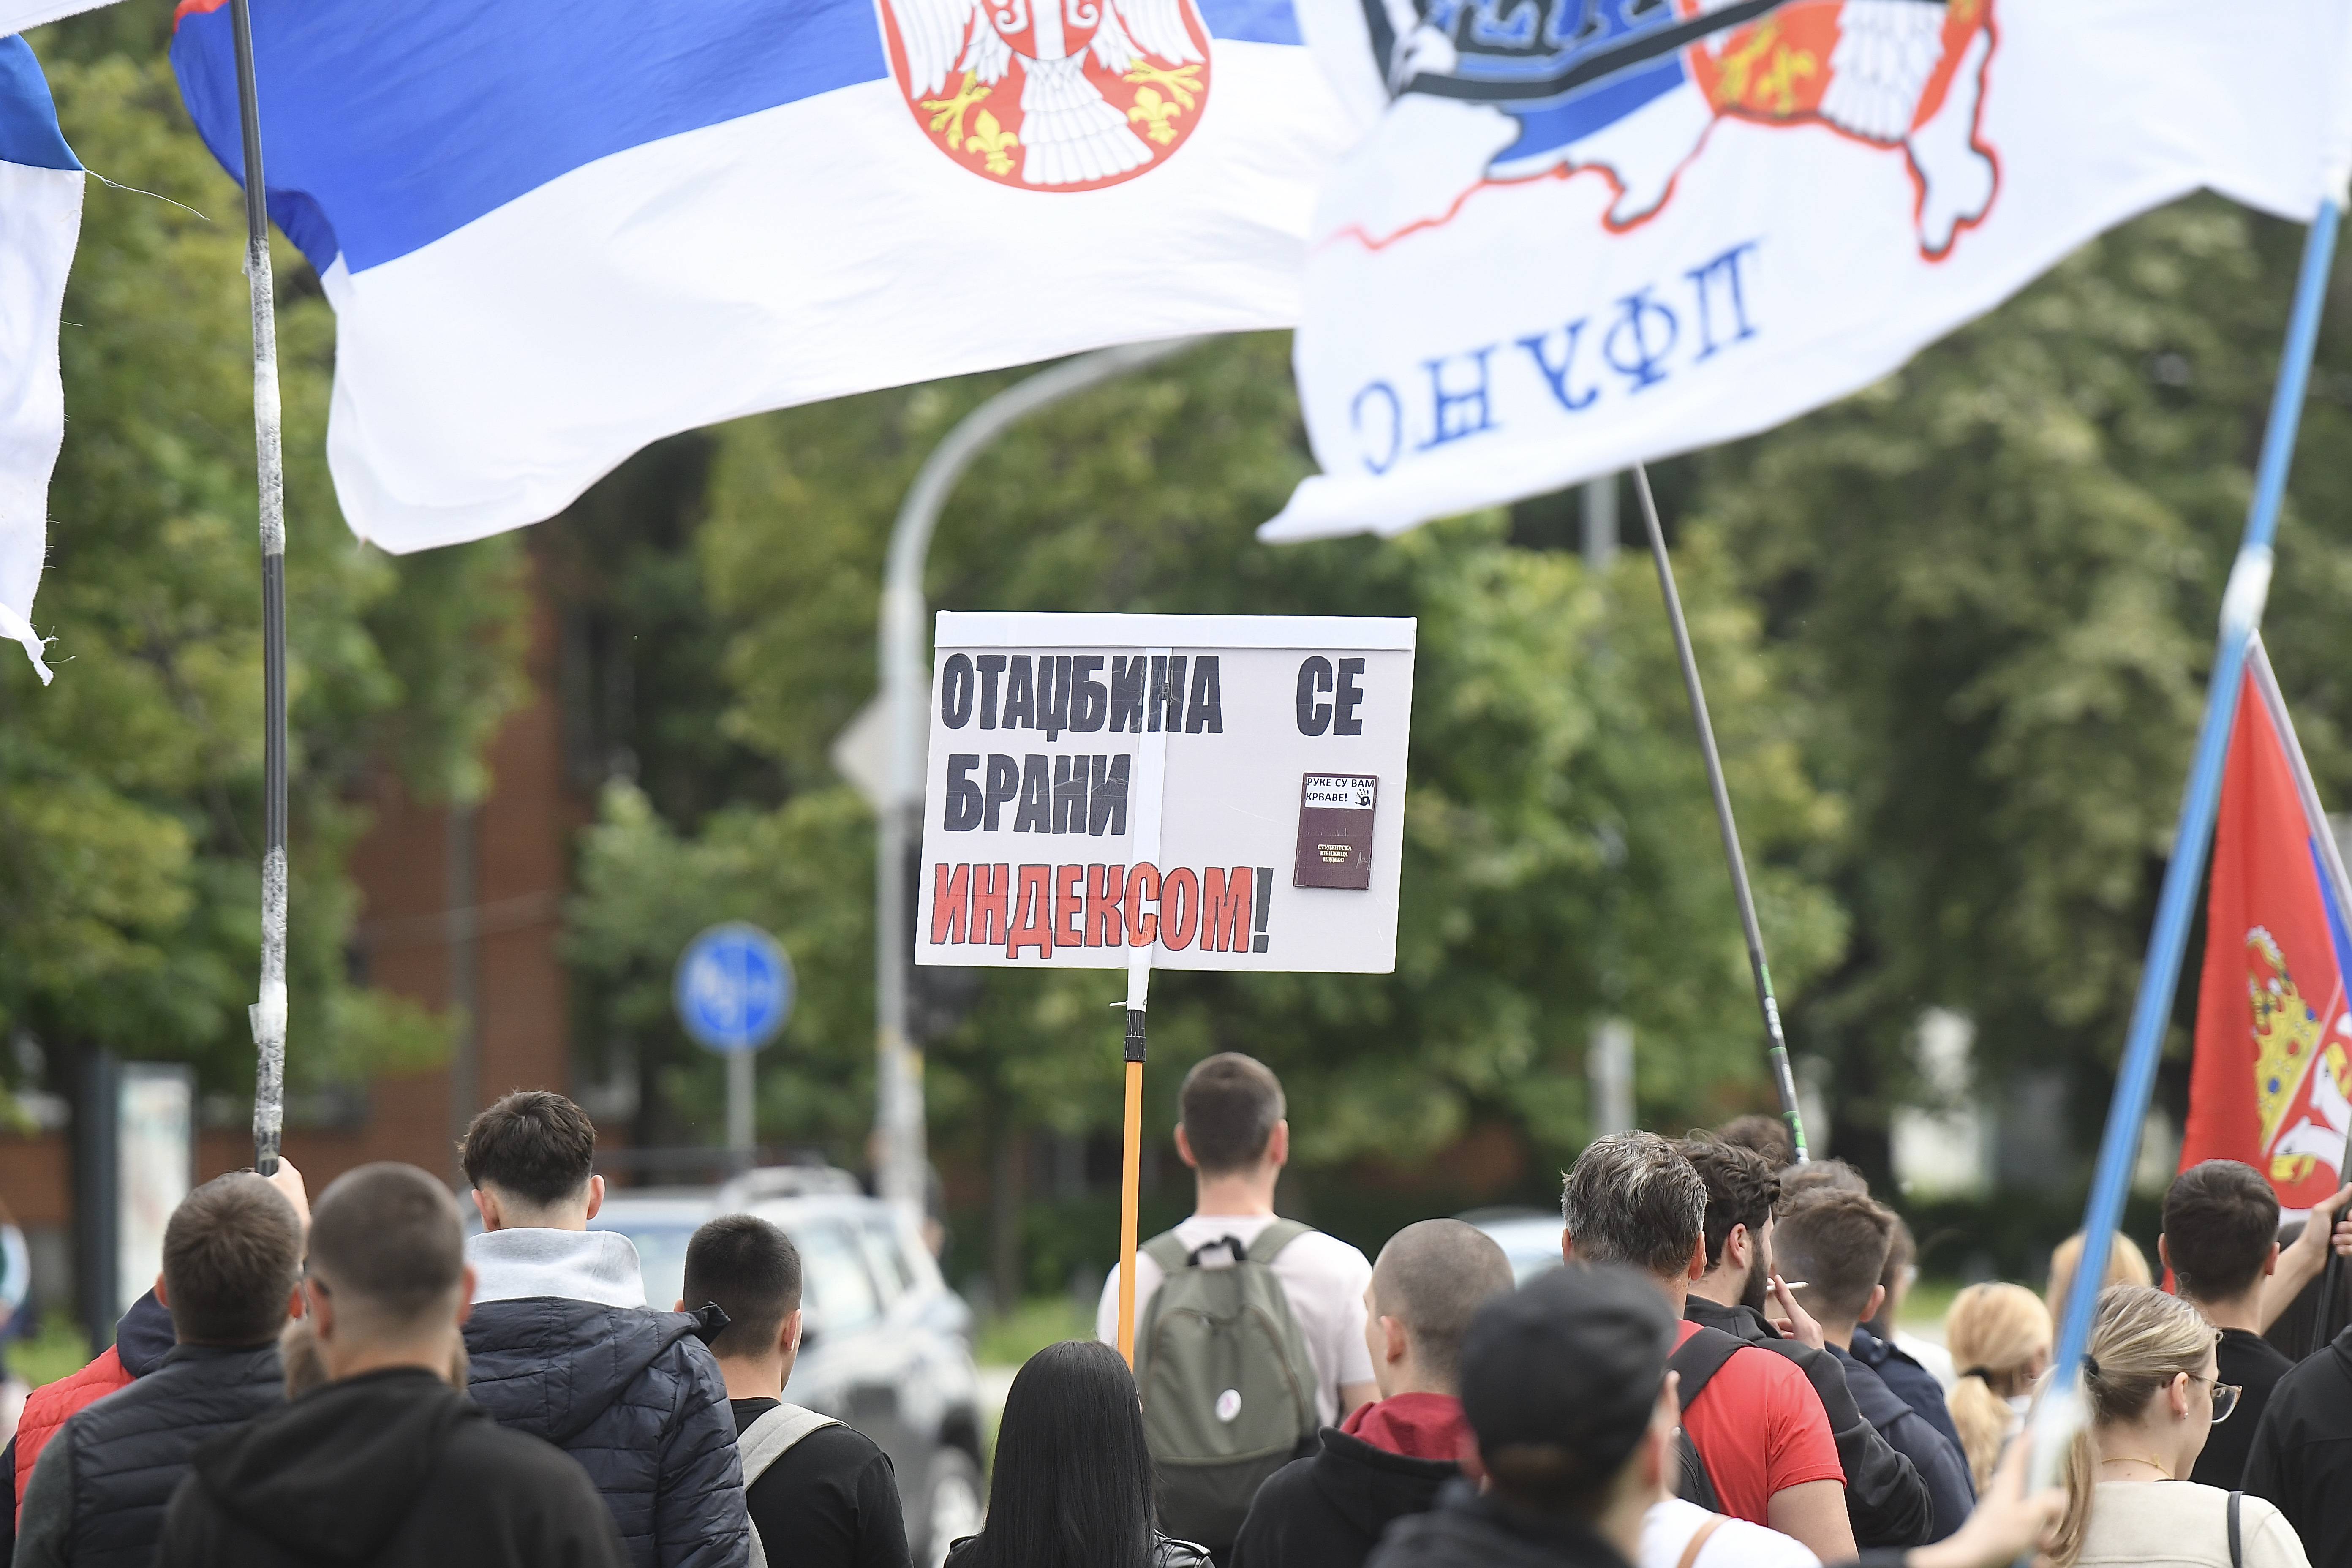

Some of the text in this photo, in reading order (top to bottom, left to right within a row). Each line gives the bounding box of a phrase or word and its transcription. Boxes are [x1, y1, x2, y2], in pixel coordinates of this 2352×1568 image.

[941, 653, 1365, 741] ОТАЏБИНА СЕ
[944, 754, 1131, 836] БРАНИ
[1306, 792, 1348, 802] КРВАВЕ!
[1307, 778, 1374, 787] РУКЕ СУ ВАМ
[930, 862, 1274, 959] ИНДЕКСОМ!
